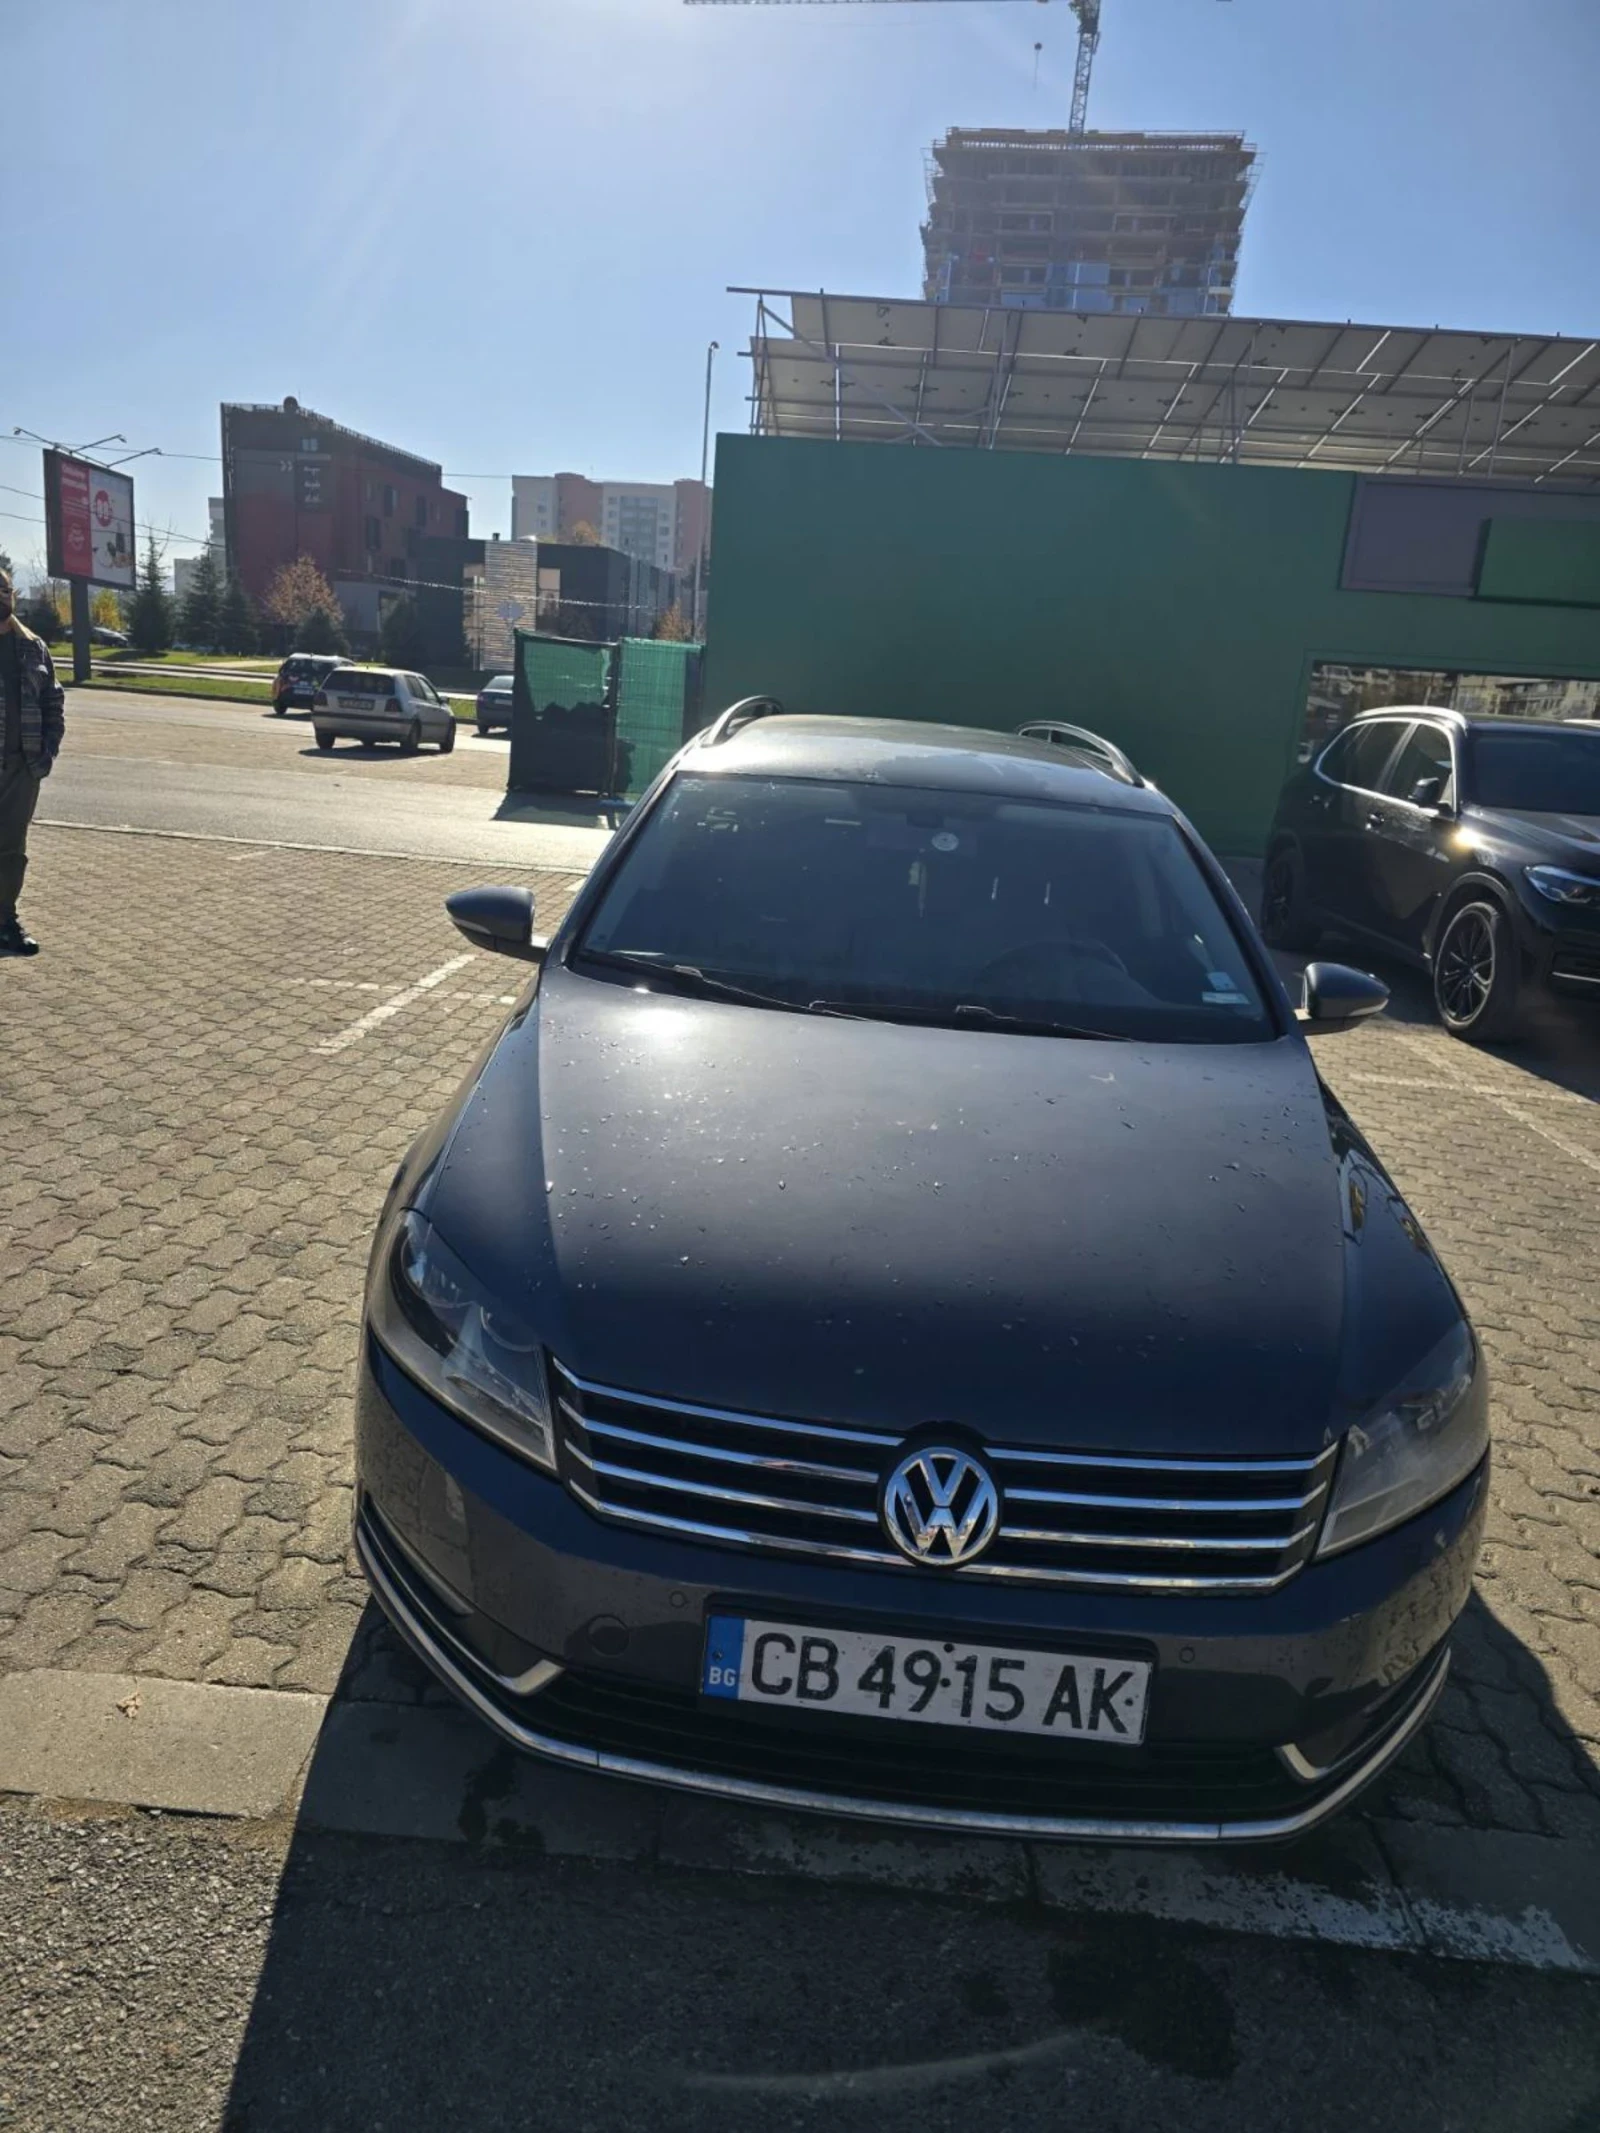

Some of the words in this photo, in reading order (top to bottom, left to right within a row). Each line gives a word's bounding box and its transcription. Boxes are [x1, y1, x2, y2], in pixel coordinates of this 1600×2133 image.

[708, 1666, 737, 1687] BG
[752, 1632, 839, 1701] CB
[857, 1645, 1025, 1722] 4915
[1042, 1665, 1134, 1734] AK
